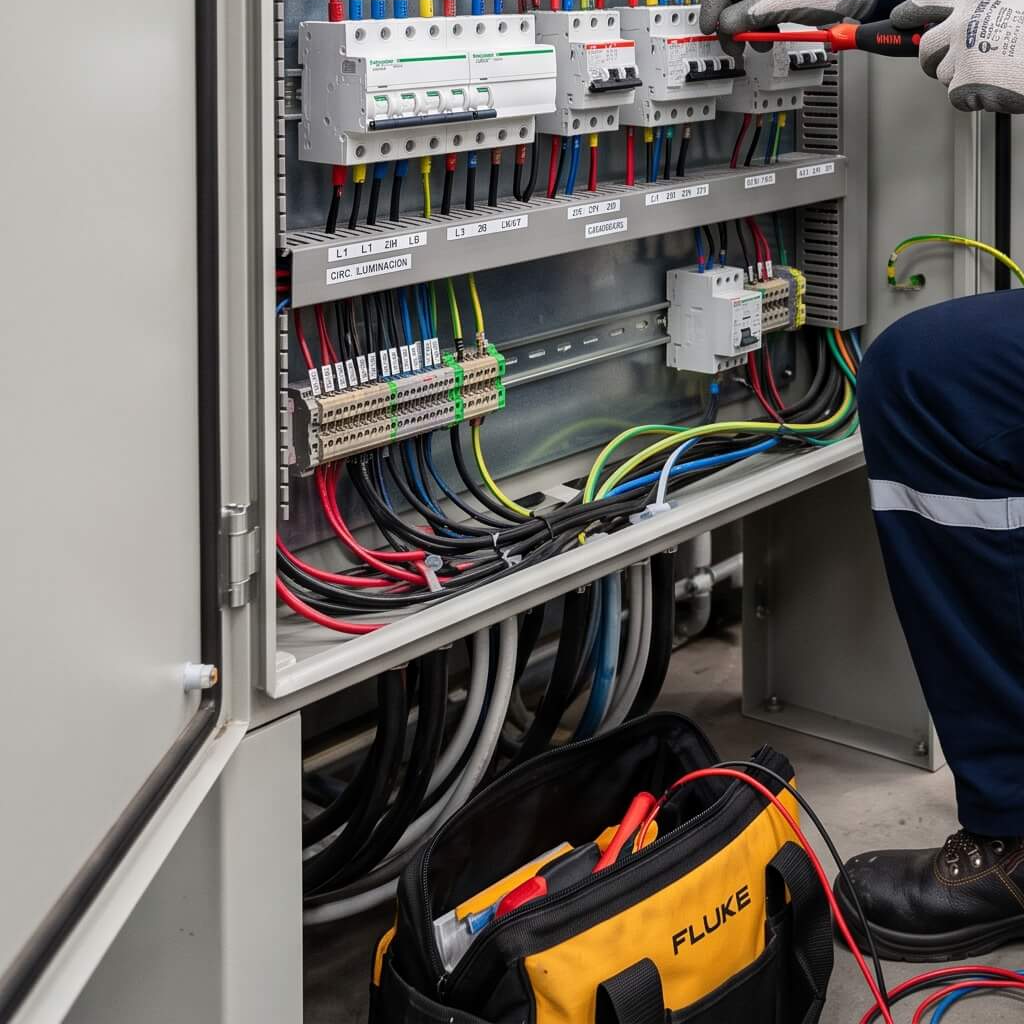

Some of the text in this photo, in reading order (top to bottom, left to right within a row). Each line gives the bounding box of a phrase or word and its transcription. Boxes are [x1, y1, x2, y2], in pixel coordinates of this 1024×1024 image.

[336, 248, 348, 258] L1
[361, 243, 372, 253] L1
[330, 269, 353, 281] CIRC.
[672, 885, 752, 956] FLUKE
